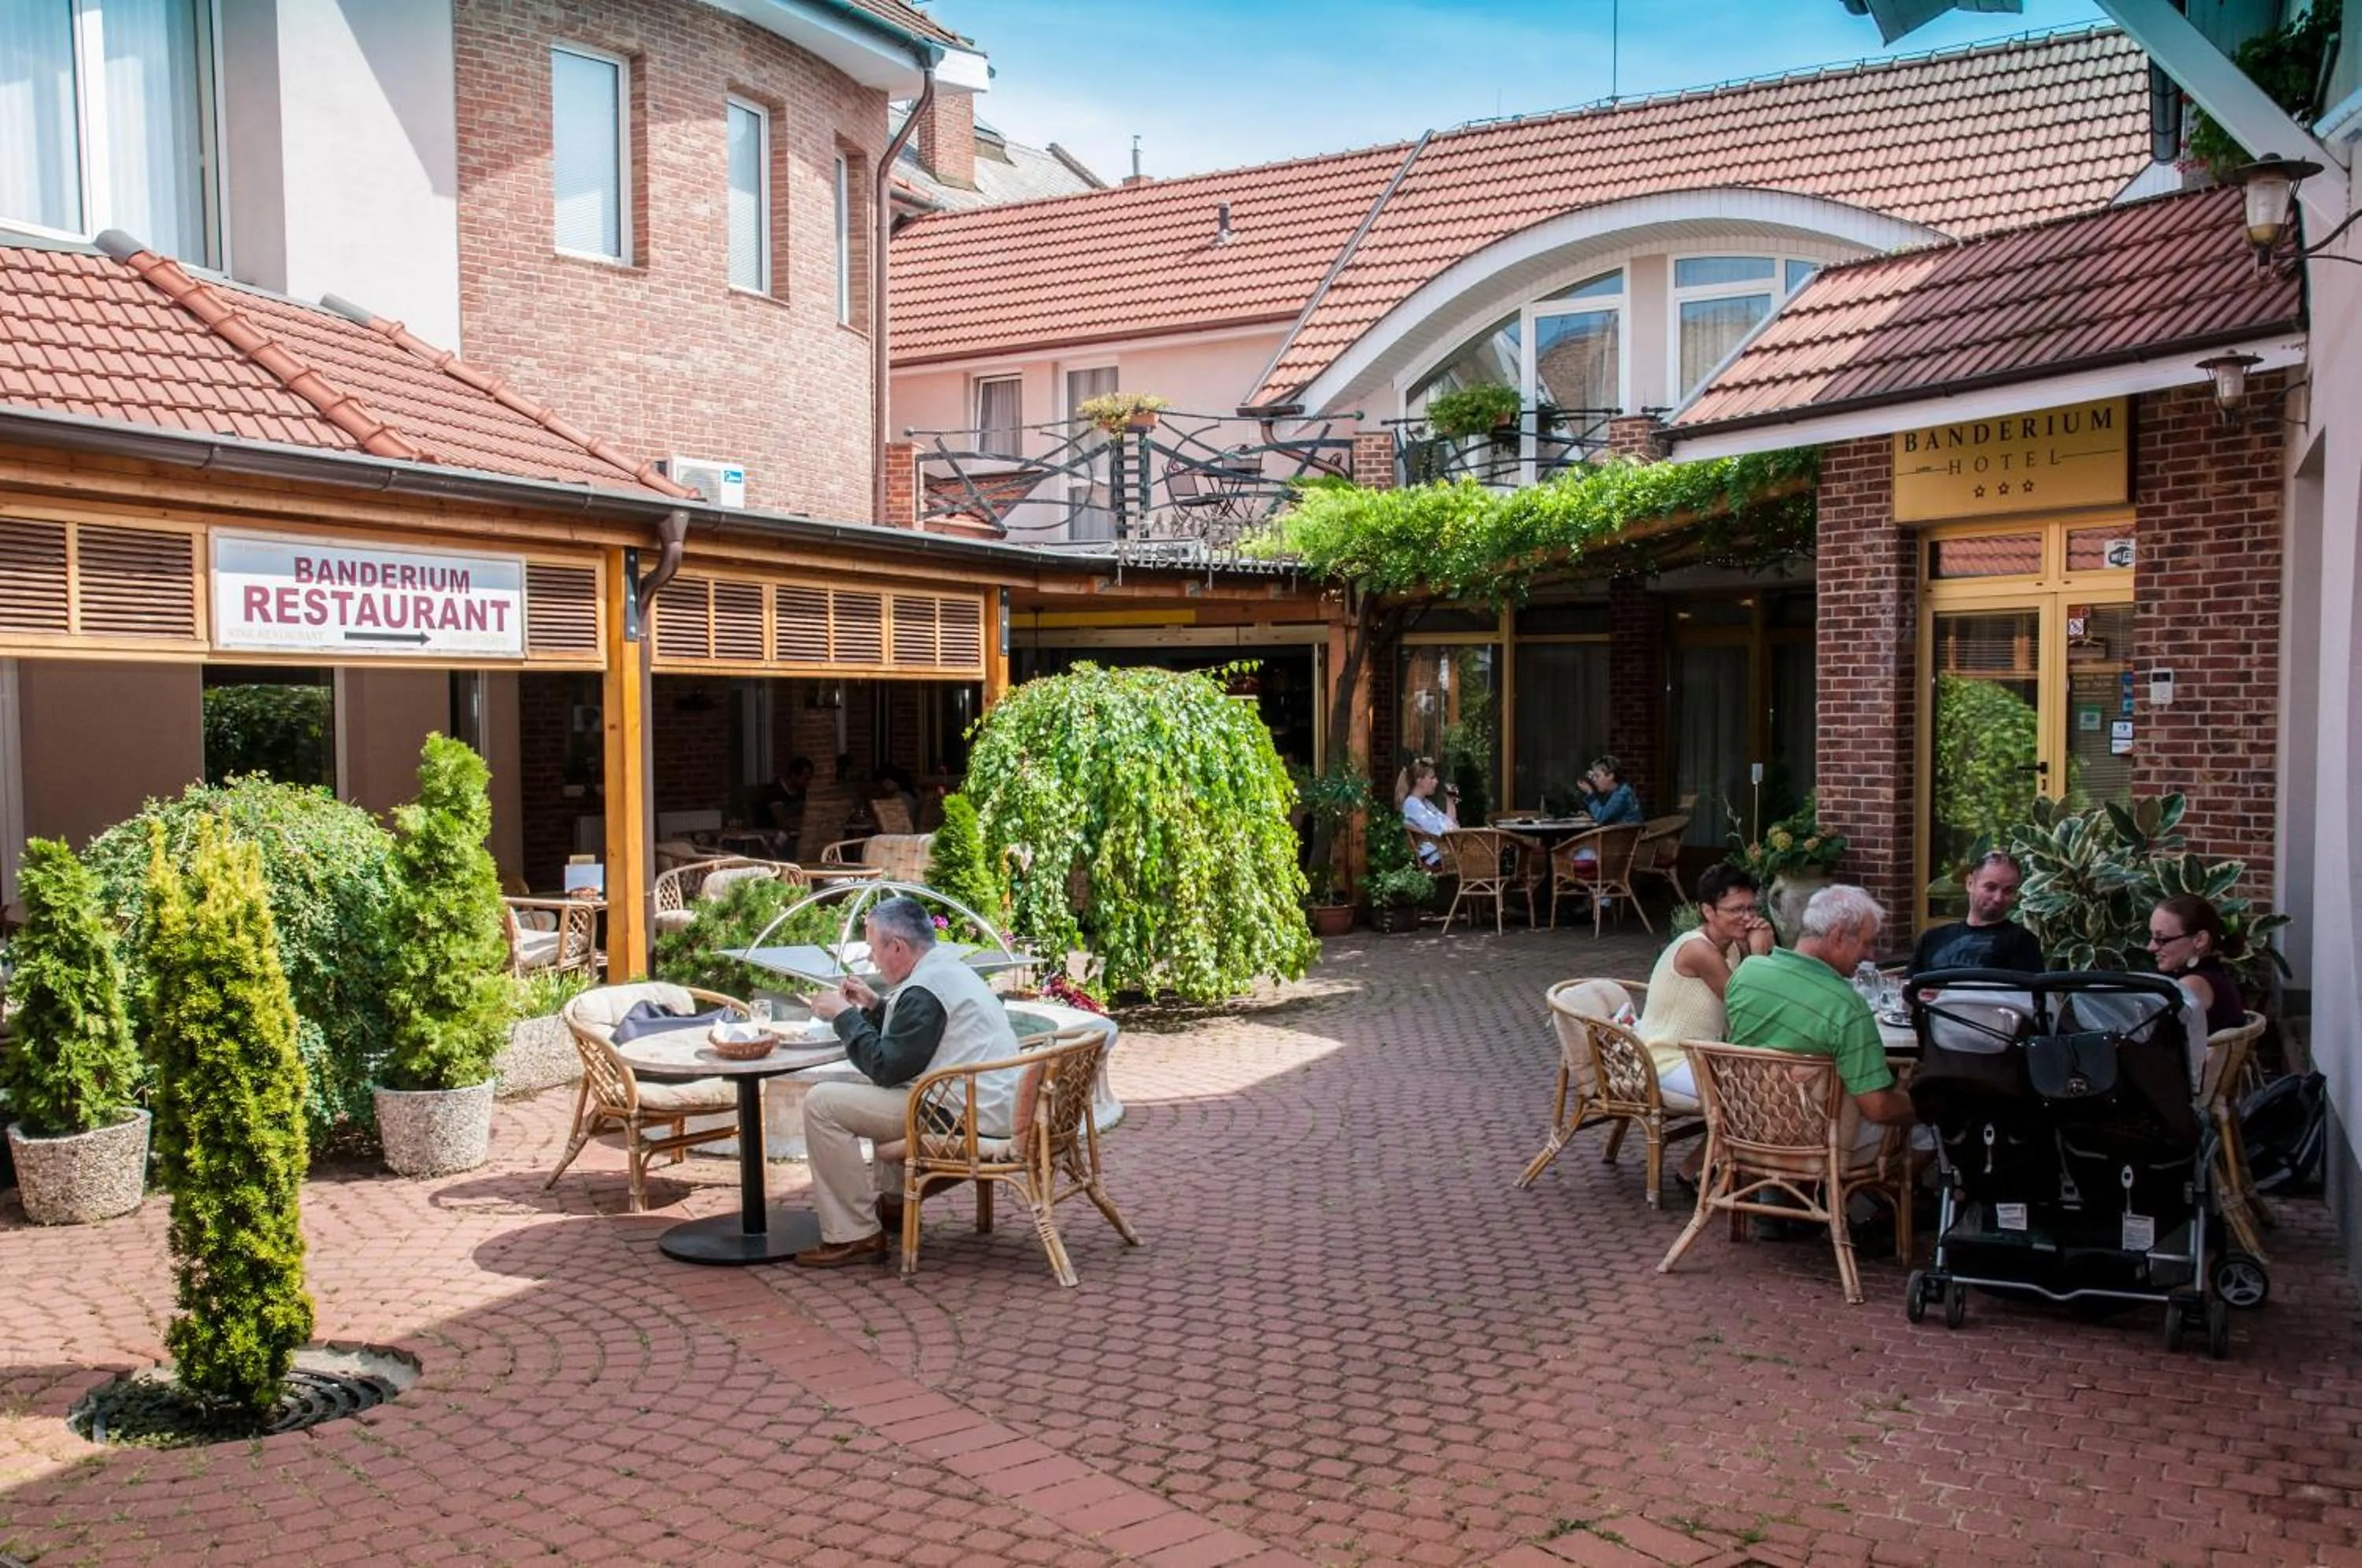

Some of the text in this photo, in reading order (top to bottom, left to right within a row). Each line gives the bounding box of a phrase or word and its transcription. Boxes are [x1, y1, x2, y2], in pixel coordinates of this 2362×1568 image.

[1905, 407, 2112, 453] BANDERIUM
[1949, 449, 2060, 475] HOTEL
[294, 556, 470, 594] BANDERIUM
[243, 585, 510, 632] RESTAURANT
